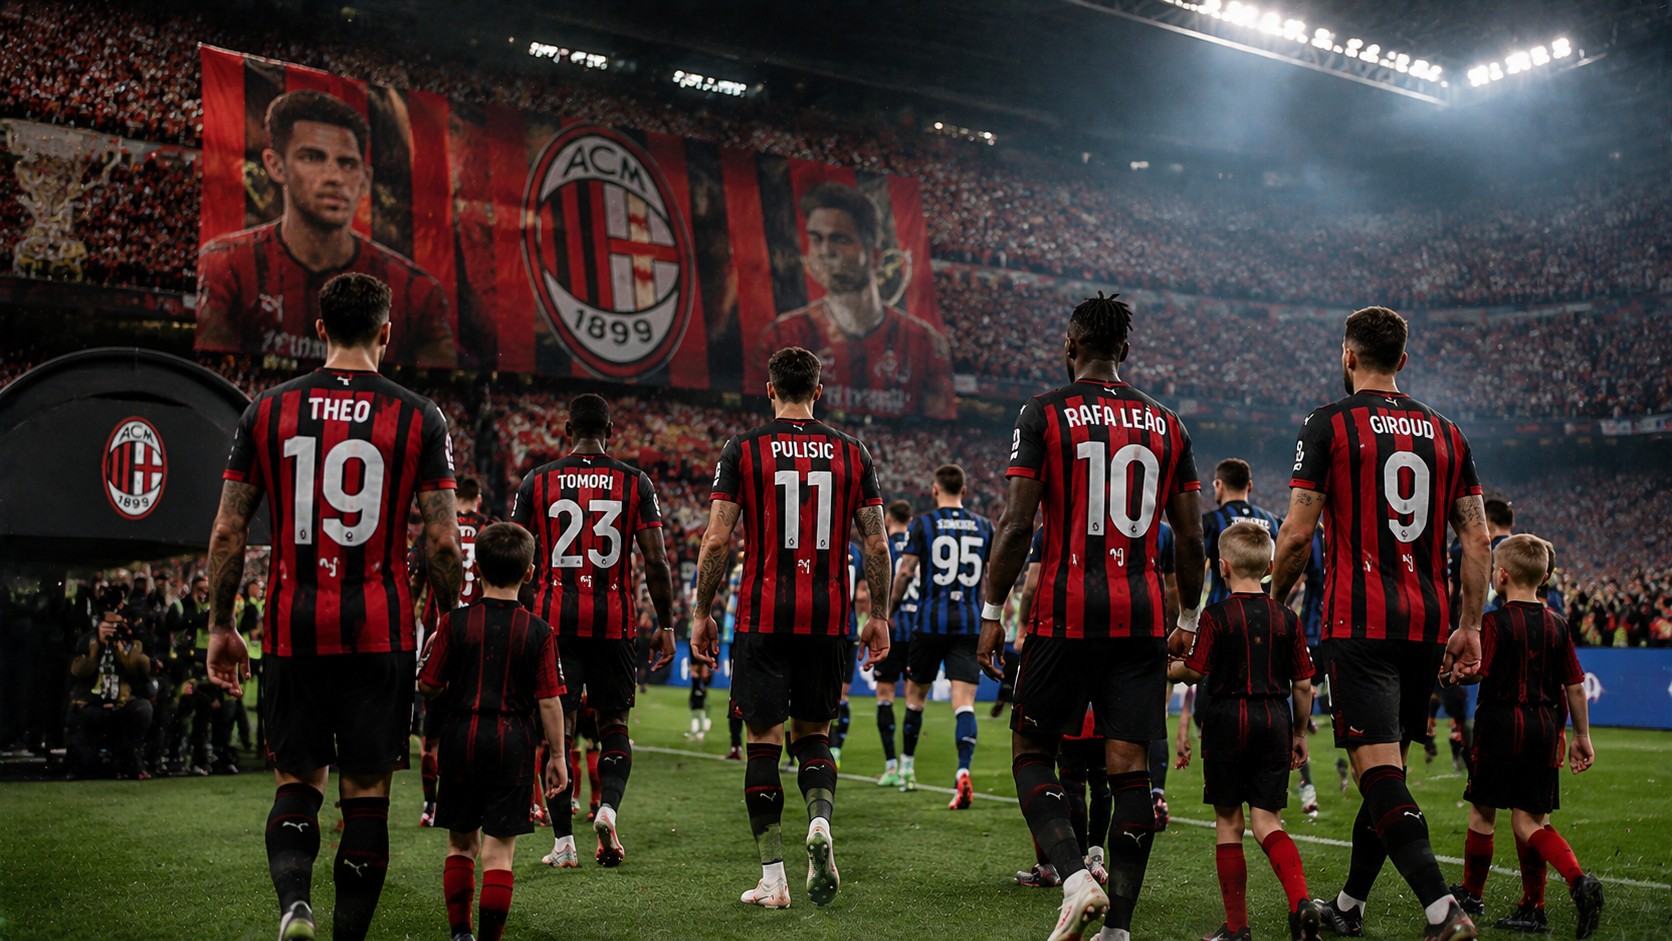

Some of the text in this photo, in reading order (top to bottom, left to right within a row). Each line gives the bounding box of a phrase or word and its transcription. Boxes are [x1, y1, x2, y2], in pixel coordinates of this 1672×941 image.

[562, 144, 647, 193] ACM
[573, 308, 654, 345] 1899
[308, 396, 371, 424] THEO
[1064, 404, 1117, 428] RAFA
[1369, 414, 1435, 440] GIROUD
[118, 424, 155, 444] ACM
[770, 441, 834, 460] PULISIC
[283, 435, 385, 547] 19
[557, 474, 614, 491] TOMORI
[1076, 441, 1160, 539] 10
[1383, 450, 1431, 543] 9
[118, 495, 150, 509] 1899
[774, 470, 833, 550] 11
[548, 498, 623, 569] 23
[931, 535, 984, 587] 95
